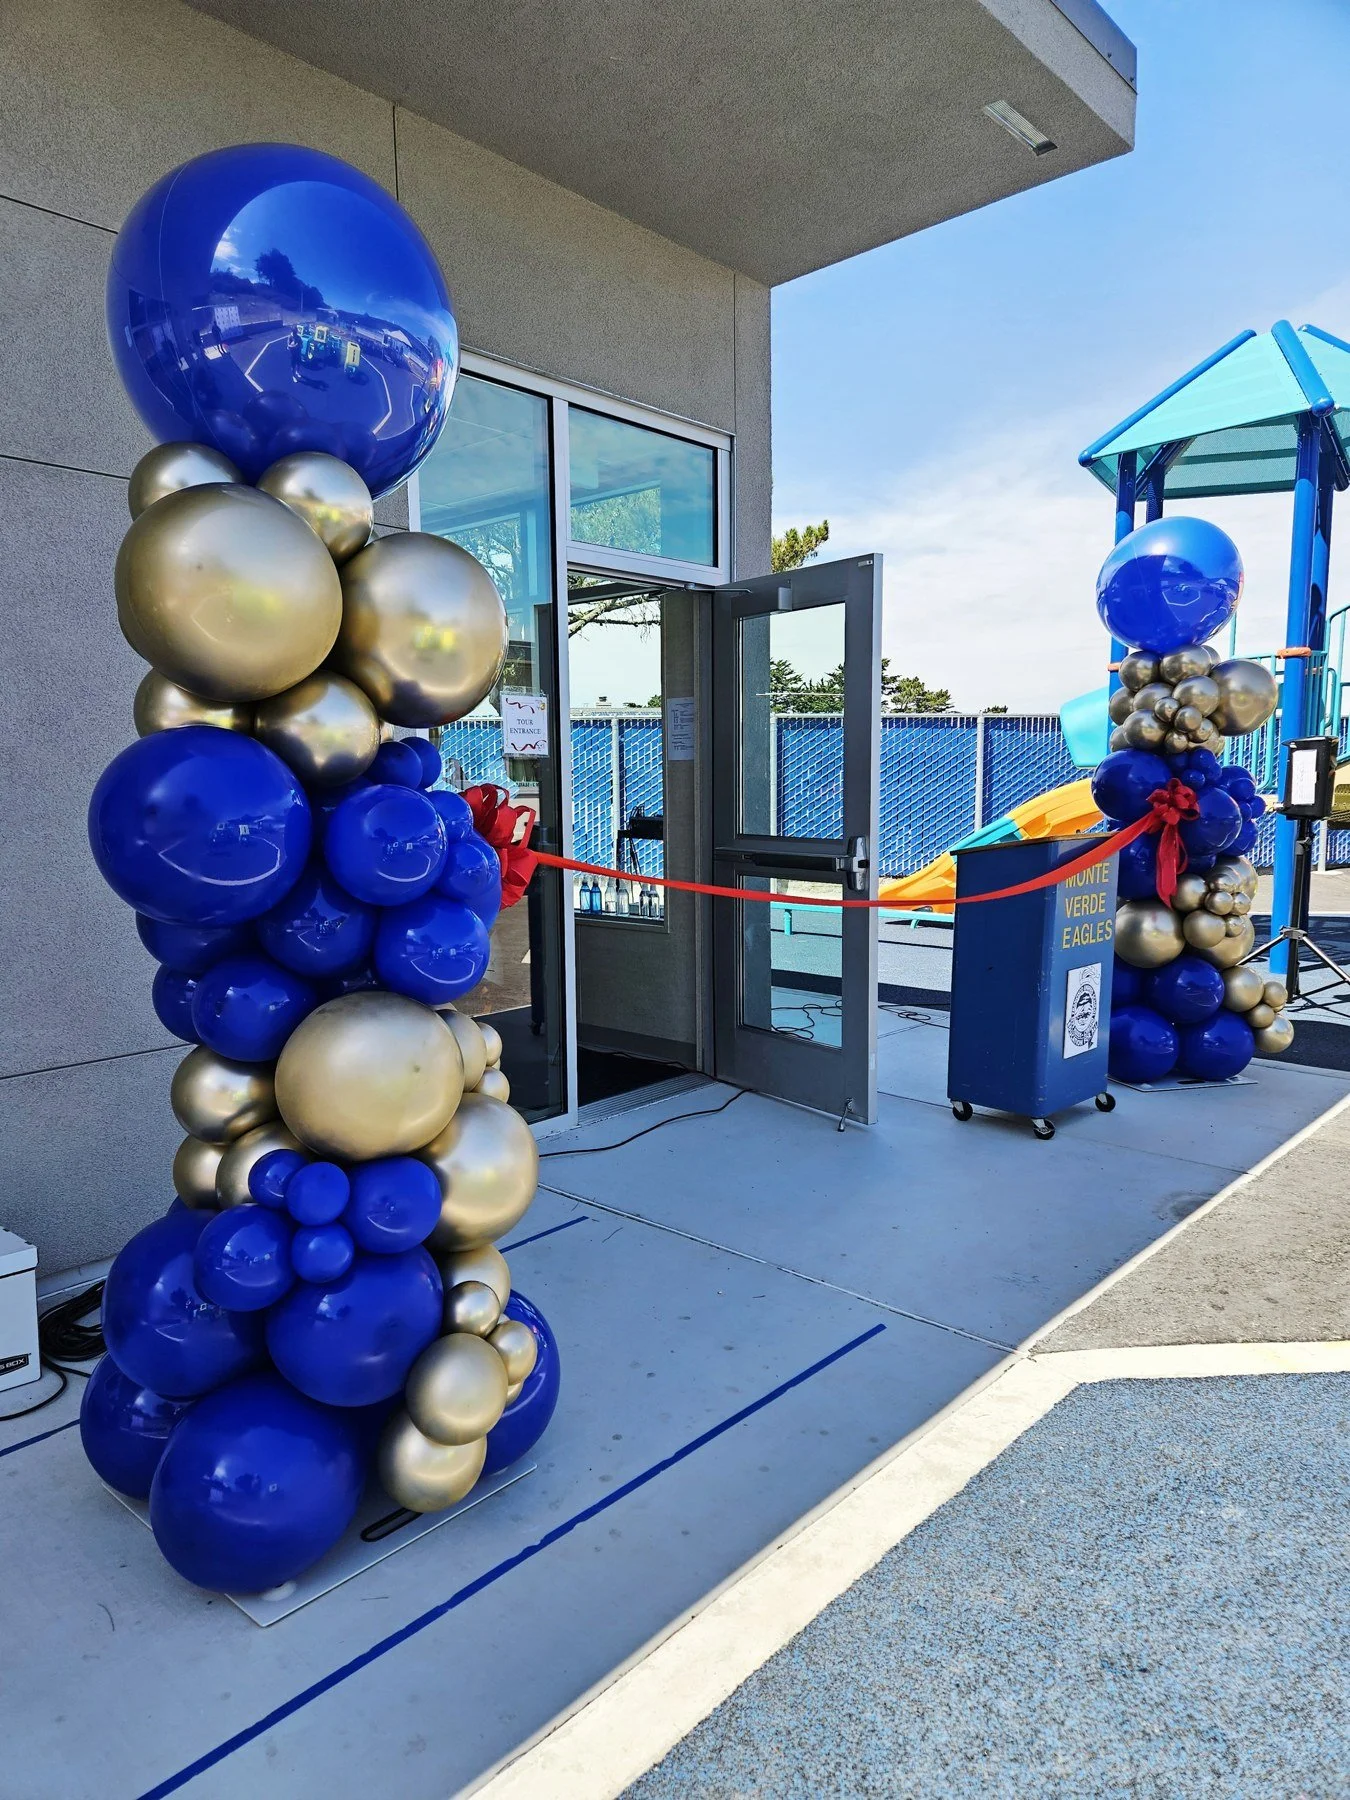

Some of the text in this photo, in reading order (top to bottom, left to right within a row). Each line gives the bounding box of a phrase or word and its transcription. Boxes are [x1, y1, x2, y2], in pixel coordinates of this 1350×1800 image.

[516, 718, 534, 726] TOUR
[510, 727, 541, 735] ENTRANCE
[1065, 892, 1107, 918] VERDE
[1063, 919, 1113, 949] EAGLES
